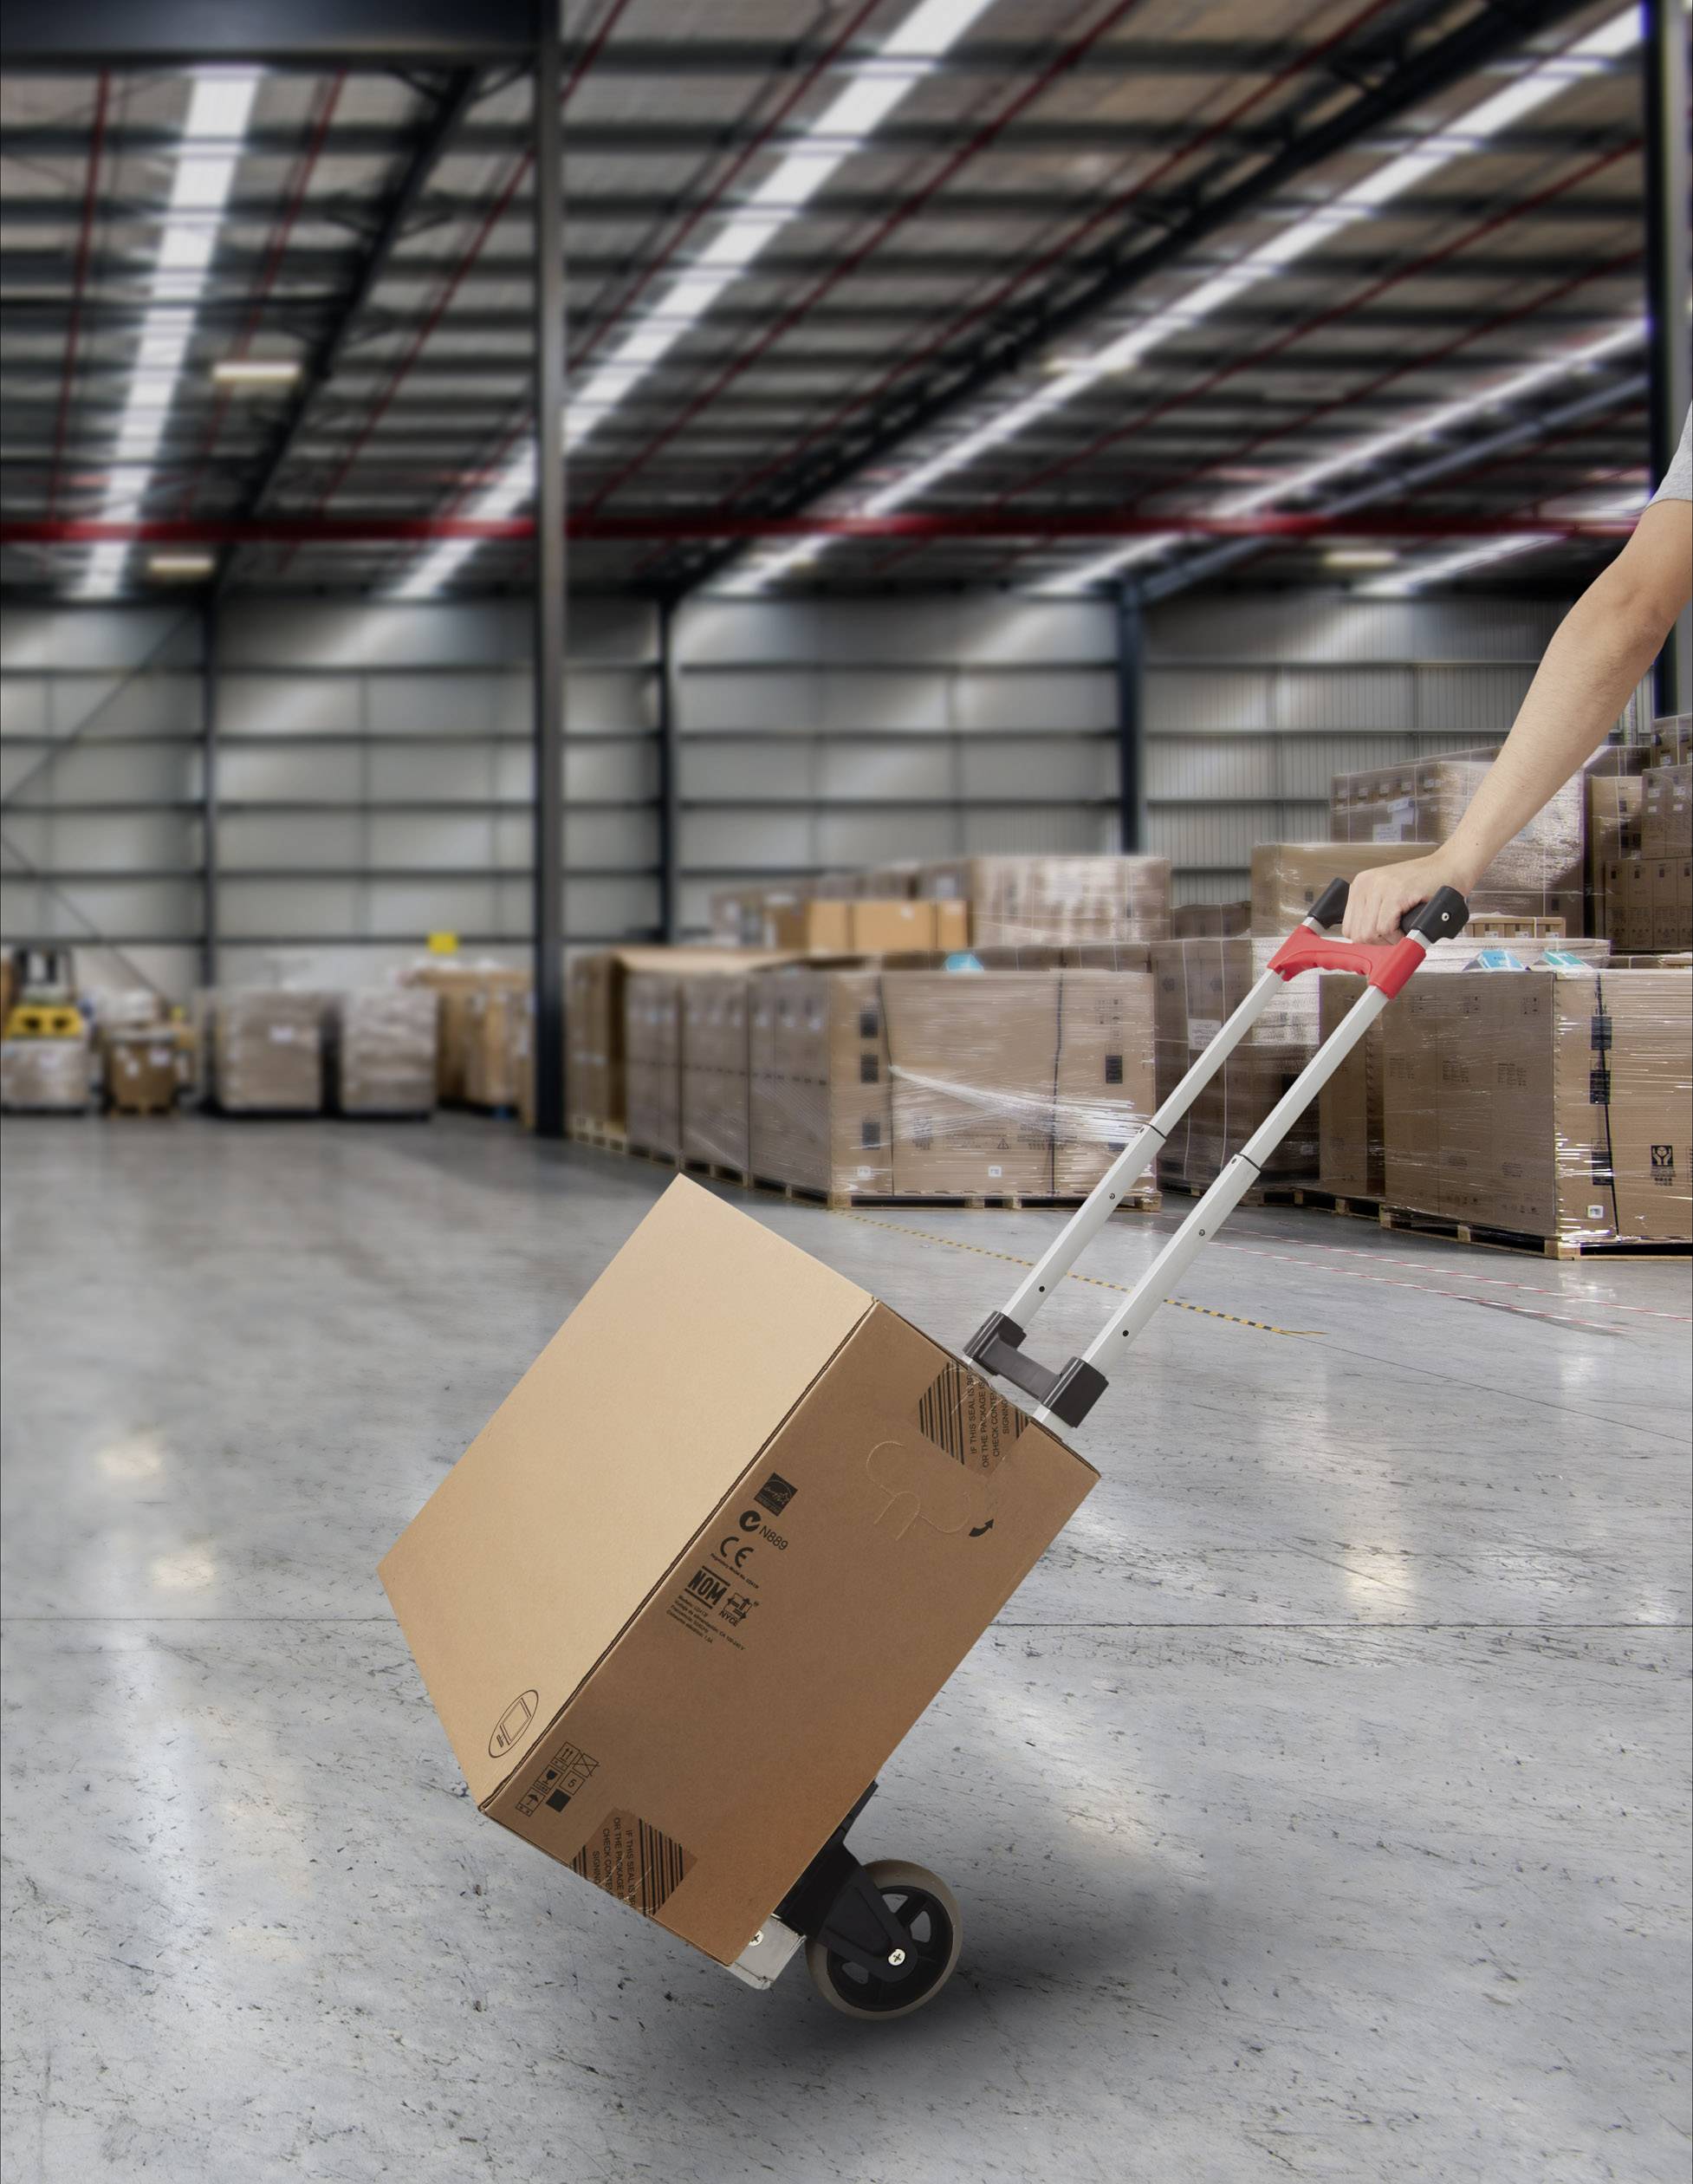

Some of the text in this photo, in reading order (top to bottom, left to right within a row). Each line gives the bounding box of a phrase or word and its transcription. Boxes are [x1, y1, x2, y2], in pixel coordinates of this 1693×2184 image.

[968, 1401, 976, 1421] SEAL
[979, 1391, 988, 1433] PACKAGE
[1002, 1399, 1010, 1434] SIGNING
[969, 1424, 977, 1445] THIS
[991, 1427, 1000, 1457] CHECK
[970, 1446, 977, 1455] IF
[982, 1455, 989, 1467] OR
[759, 1525, 788, 1550] N889
[688, 1570, 728, 1606] NOM
[719, 1610, 740, 1628] NYCE
[613, 1817, 621, 1831] OR
[602, 1828, 611, 1857] CHECK
[614, 1832, 623, 1849] THE
[626, 1839, 634, 1860] THIS
[615, 1851, 624, 1890] PACKAGE
[626, 1861, 635, 1882] SEAL
